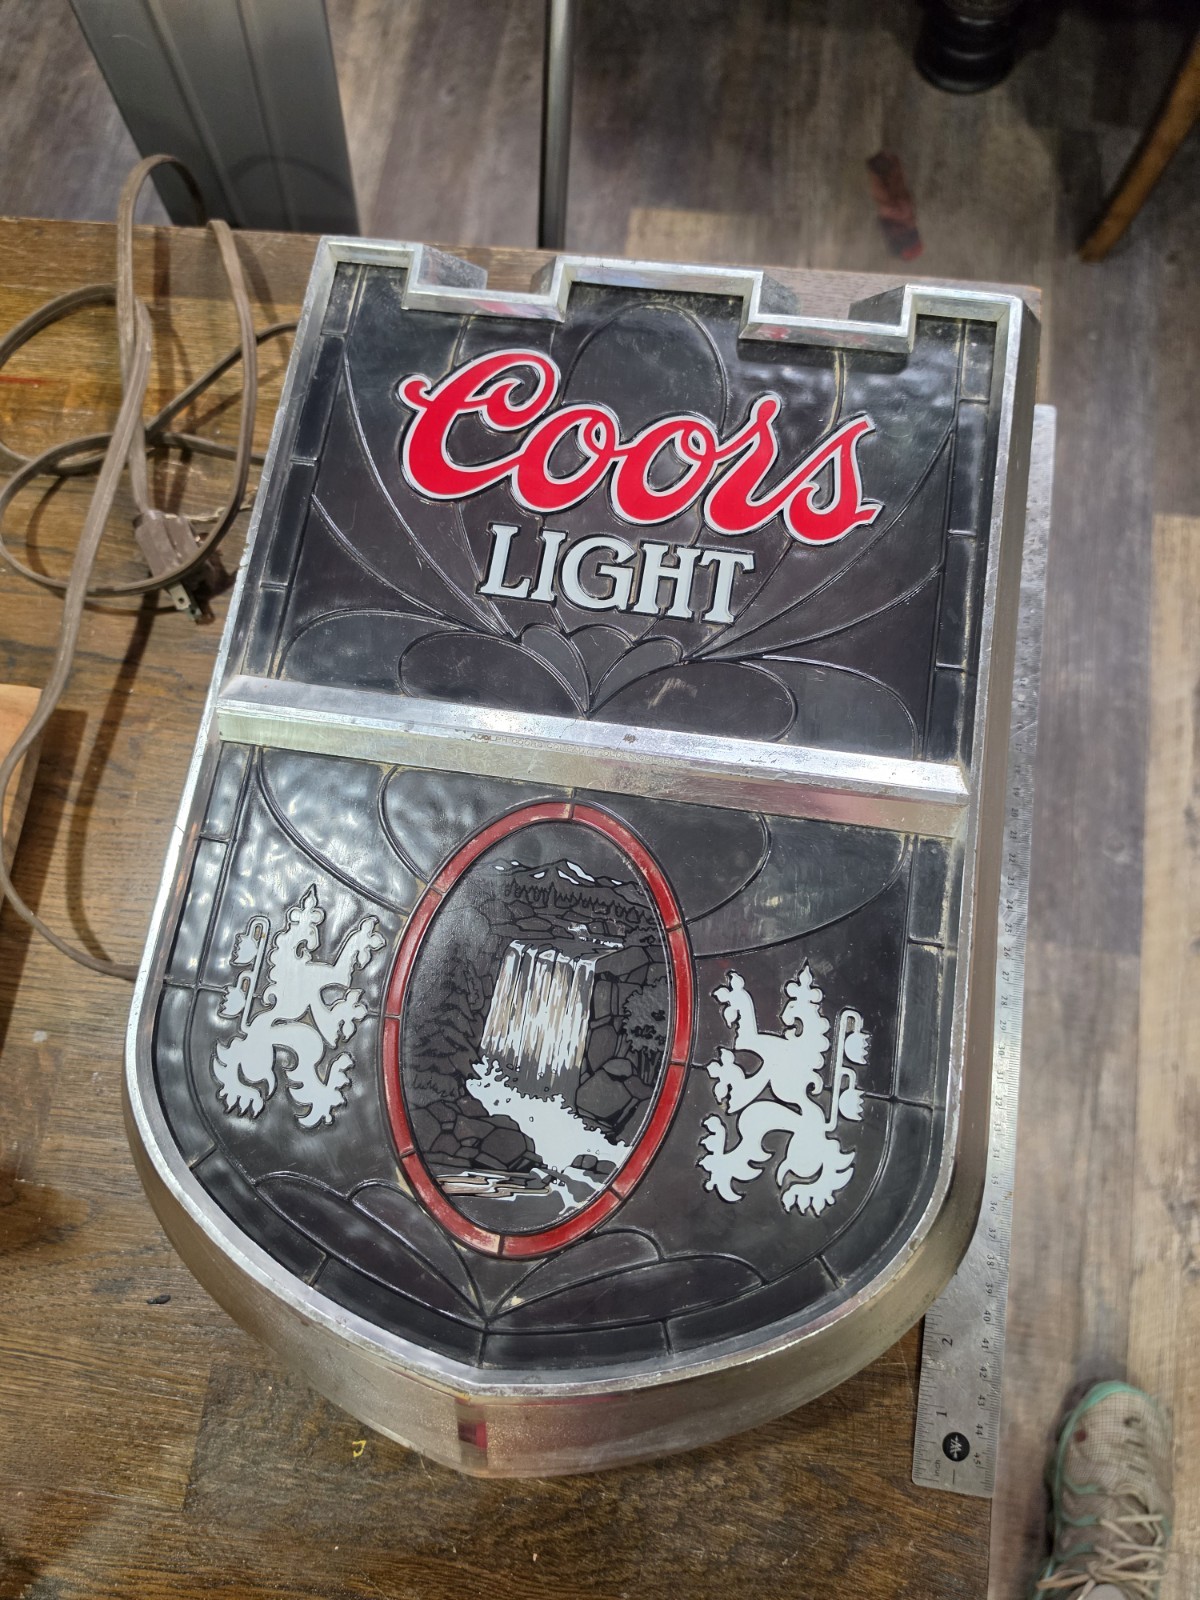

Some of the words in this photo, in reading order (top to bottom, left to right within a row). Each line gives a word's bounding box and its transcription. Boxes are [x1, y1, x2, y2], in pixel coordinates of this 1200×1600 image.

[398, 347, 883, 546] Coors
[479, 523, 754, 624] LIGHT
[470, 732, 507, 743] ADOLPH
[511, 737, 543, 747] COORS
[1011, 808, 1018, 817] 20
[1010, 831, 1017, 839] 21
[1009, 853, 1016, 863] 22
[1008, 876, 1015, 886] 23
[1006, 899, 1013, 909] 24
[1005, 923, 1012, 933] 25
[1004, 947, 1011, 957] 26
[1002, 971, 1009, 981] 27
[1001, 996, 1008, 1005] 28
[1000, 1020, 1007, 1030] 29
[998, 1046, 1005, 1055] 30
[997, 1071, 1004, 1080] 31
[995, 1097, 1003, 1107] 32
[994, 1122, 1001, 1132] 33
[993, 1148, 1000, 1159] 34
[992, 1174, 998, 1185] 35
[990, 1201, 997, 1211] 36
[989, 1228, 996, 1240] 37
[987, 1255, 994, 1266] 38
[985, 1283, 993, 1294] 39
[984, 1310, 990, 1321] 40
[942, 1337, 952, 1347] 2
[982, 1338, 989, 1349] 41
[980, 1367, 987, 1378] 42
[978, 1395, 985, 1407] 43
[976, 1424, 983, 1435] 44
[974, 1453, 981, 1465] 45
